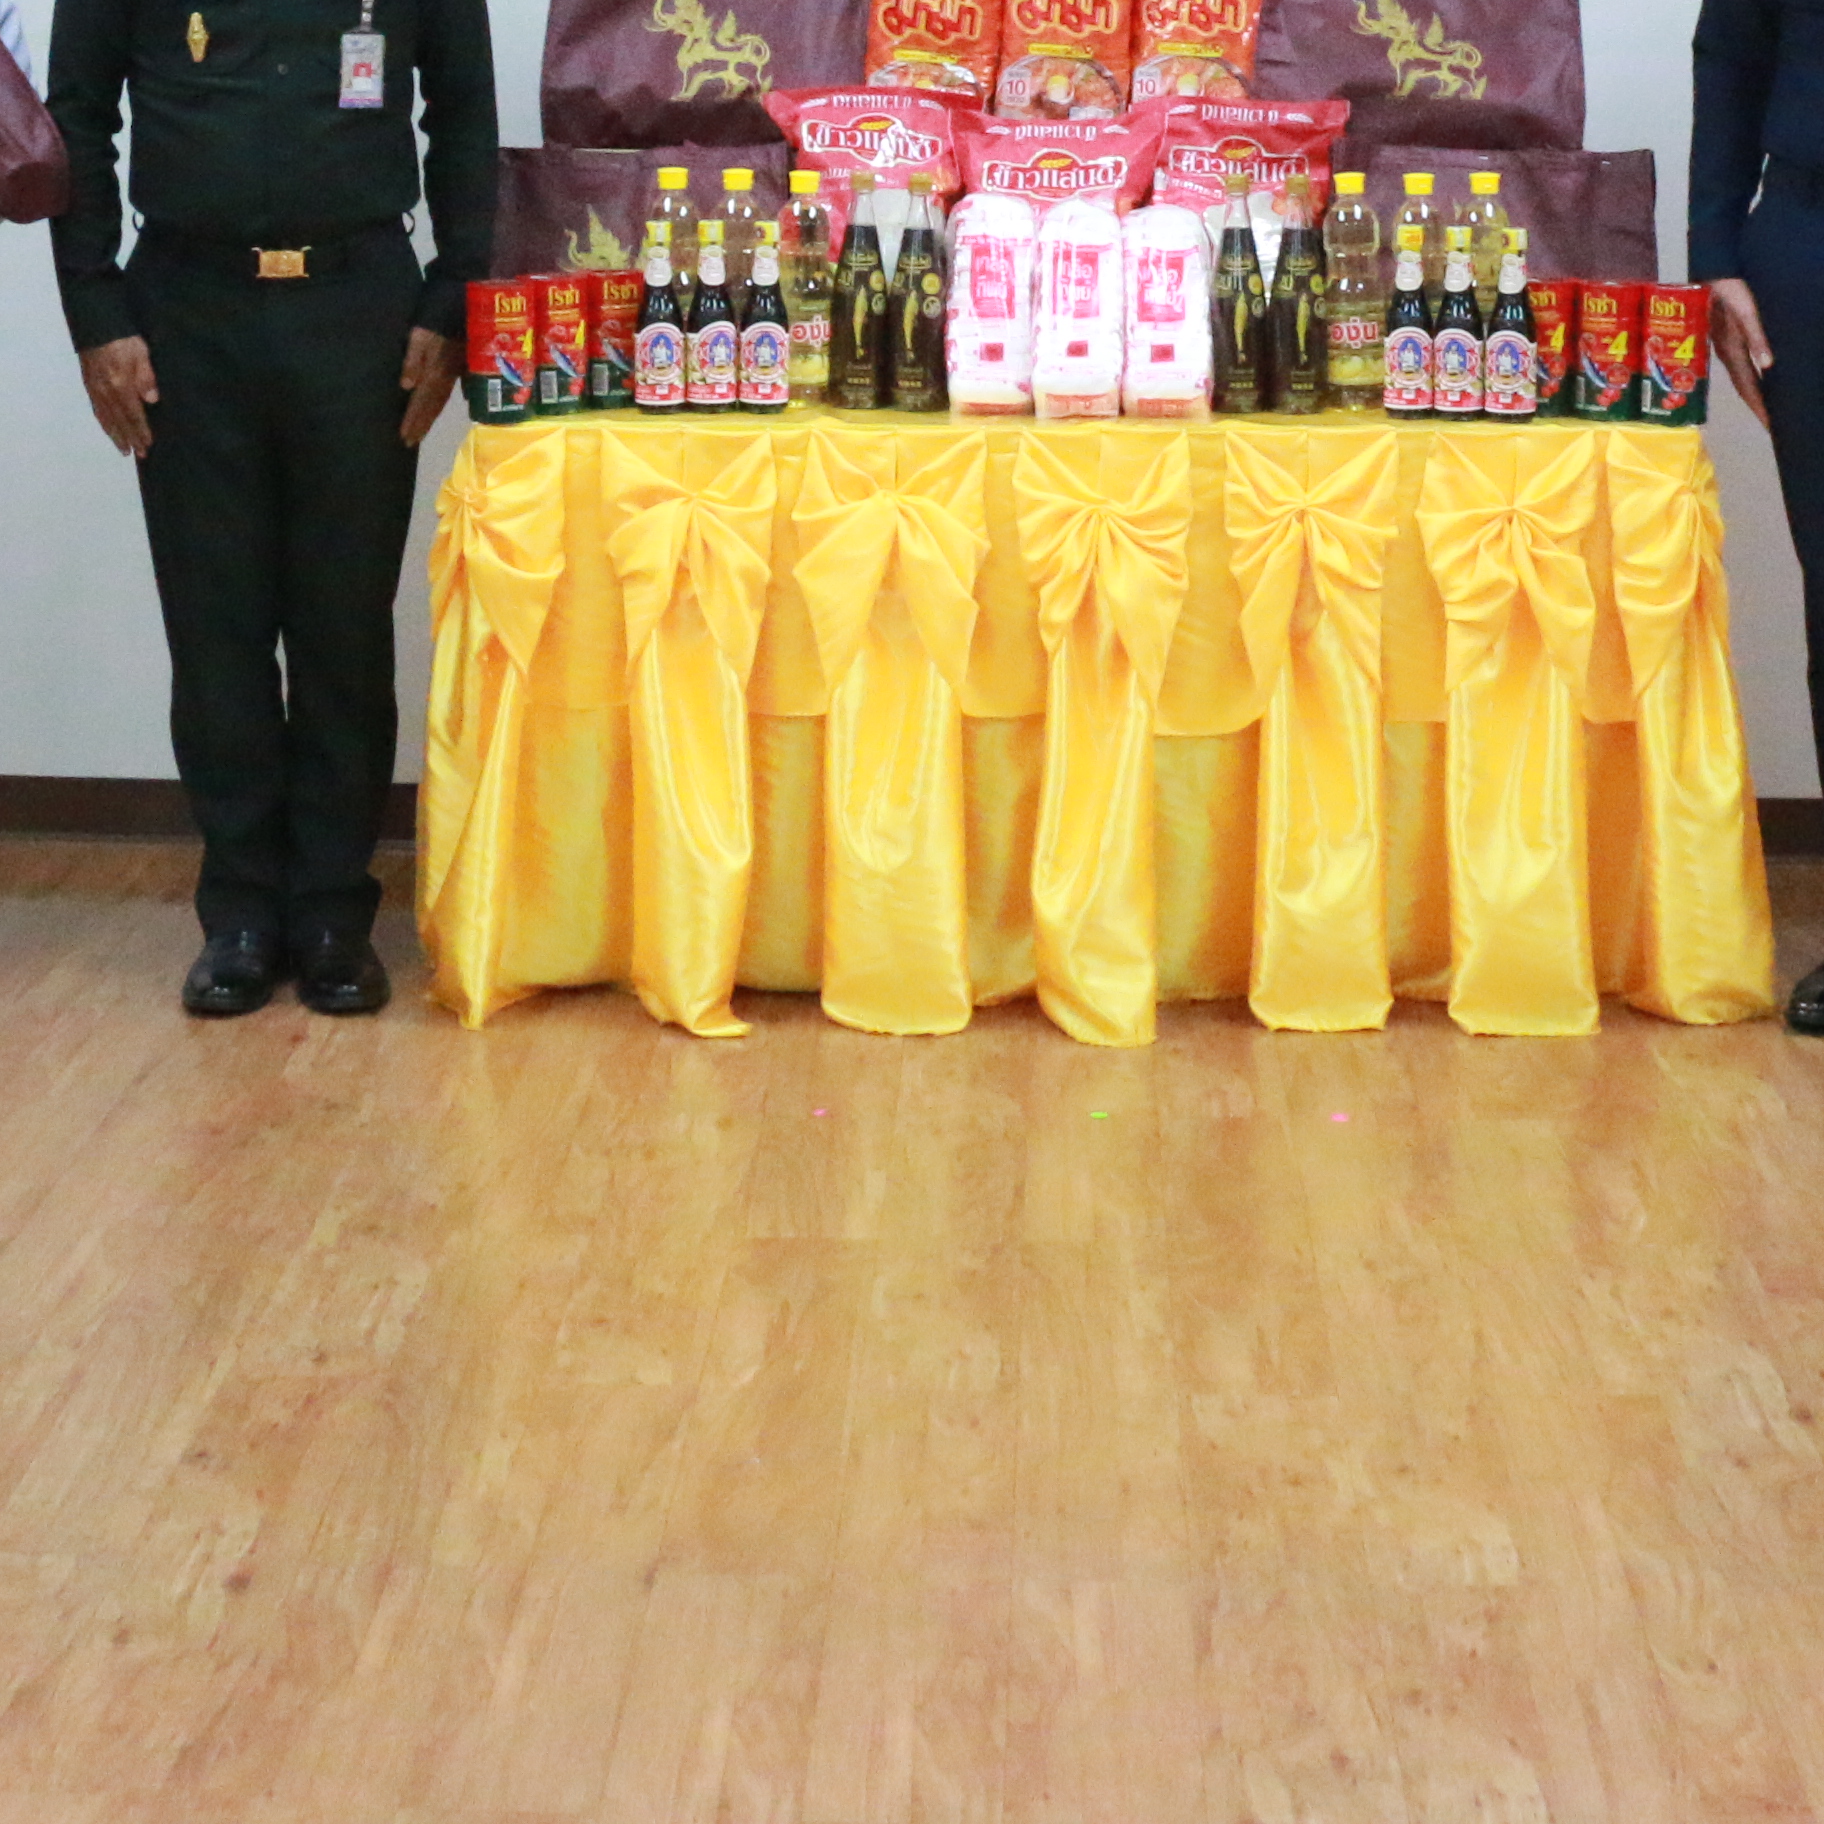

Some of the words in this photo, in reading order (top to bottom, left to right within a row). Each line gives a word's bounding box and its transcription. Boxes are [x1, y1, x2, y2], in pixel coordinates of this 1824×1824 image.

[1007, 80, 1026, 95] 10
[1136, 79, 1156, 95] 10
[1529, 285, 1557, 307] รซ่า
[1330, 316, 1379, 350] องุ่น
[1608, 330, 1629, 363] 4
[1673, 334, 1696, 367] 4
